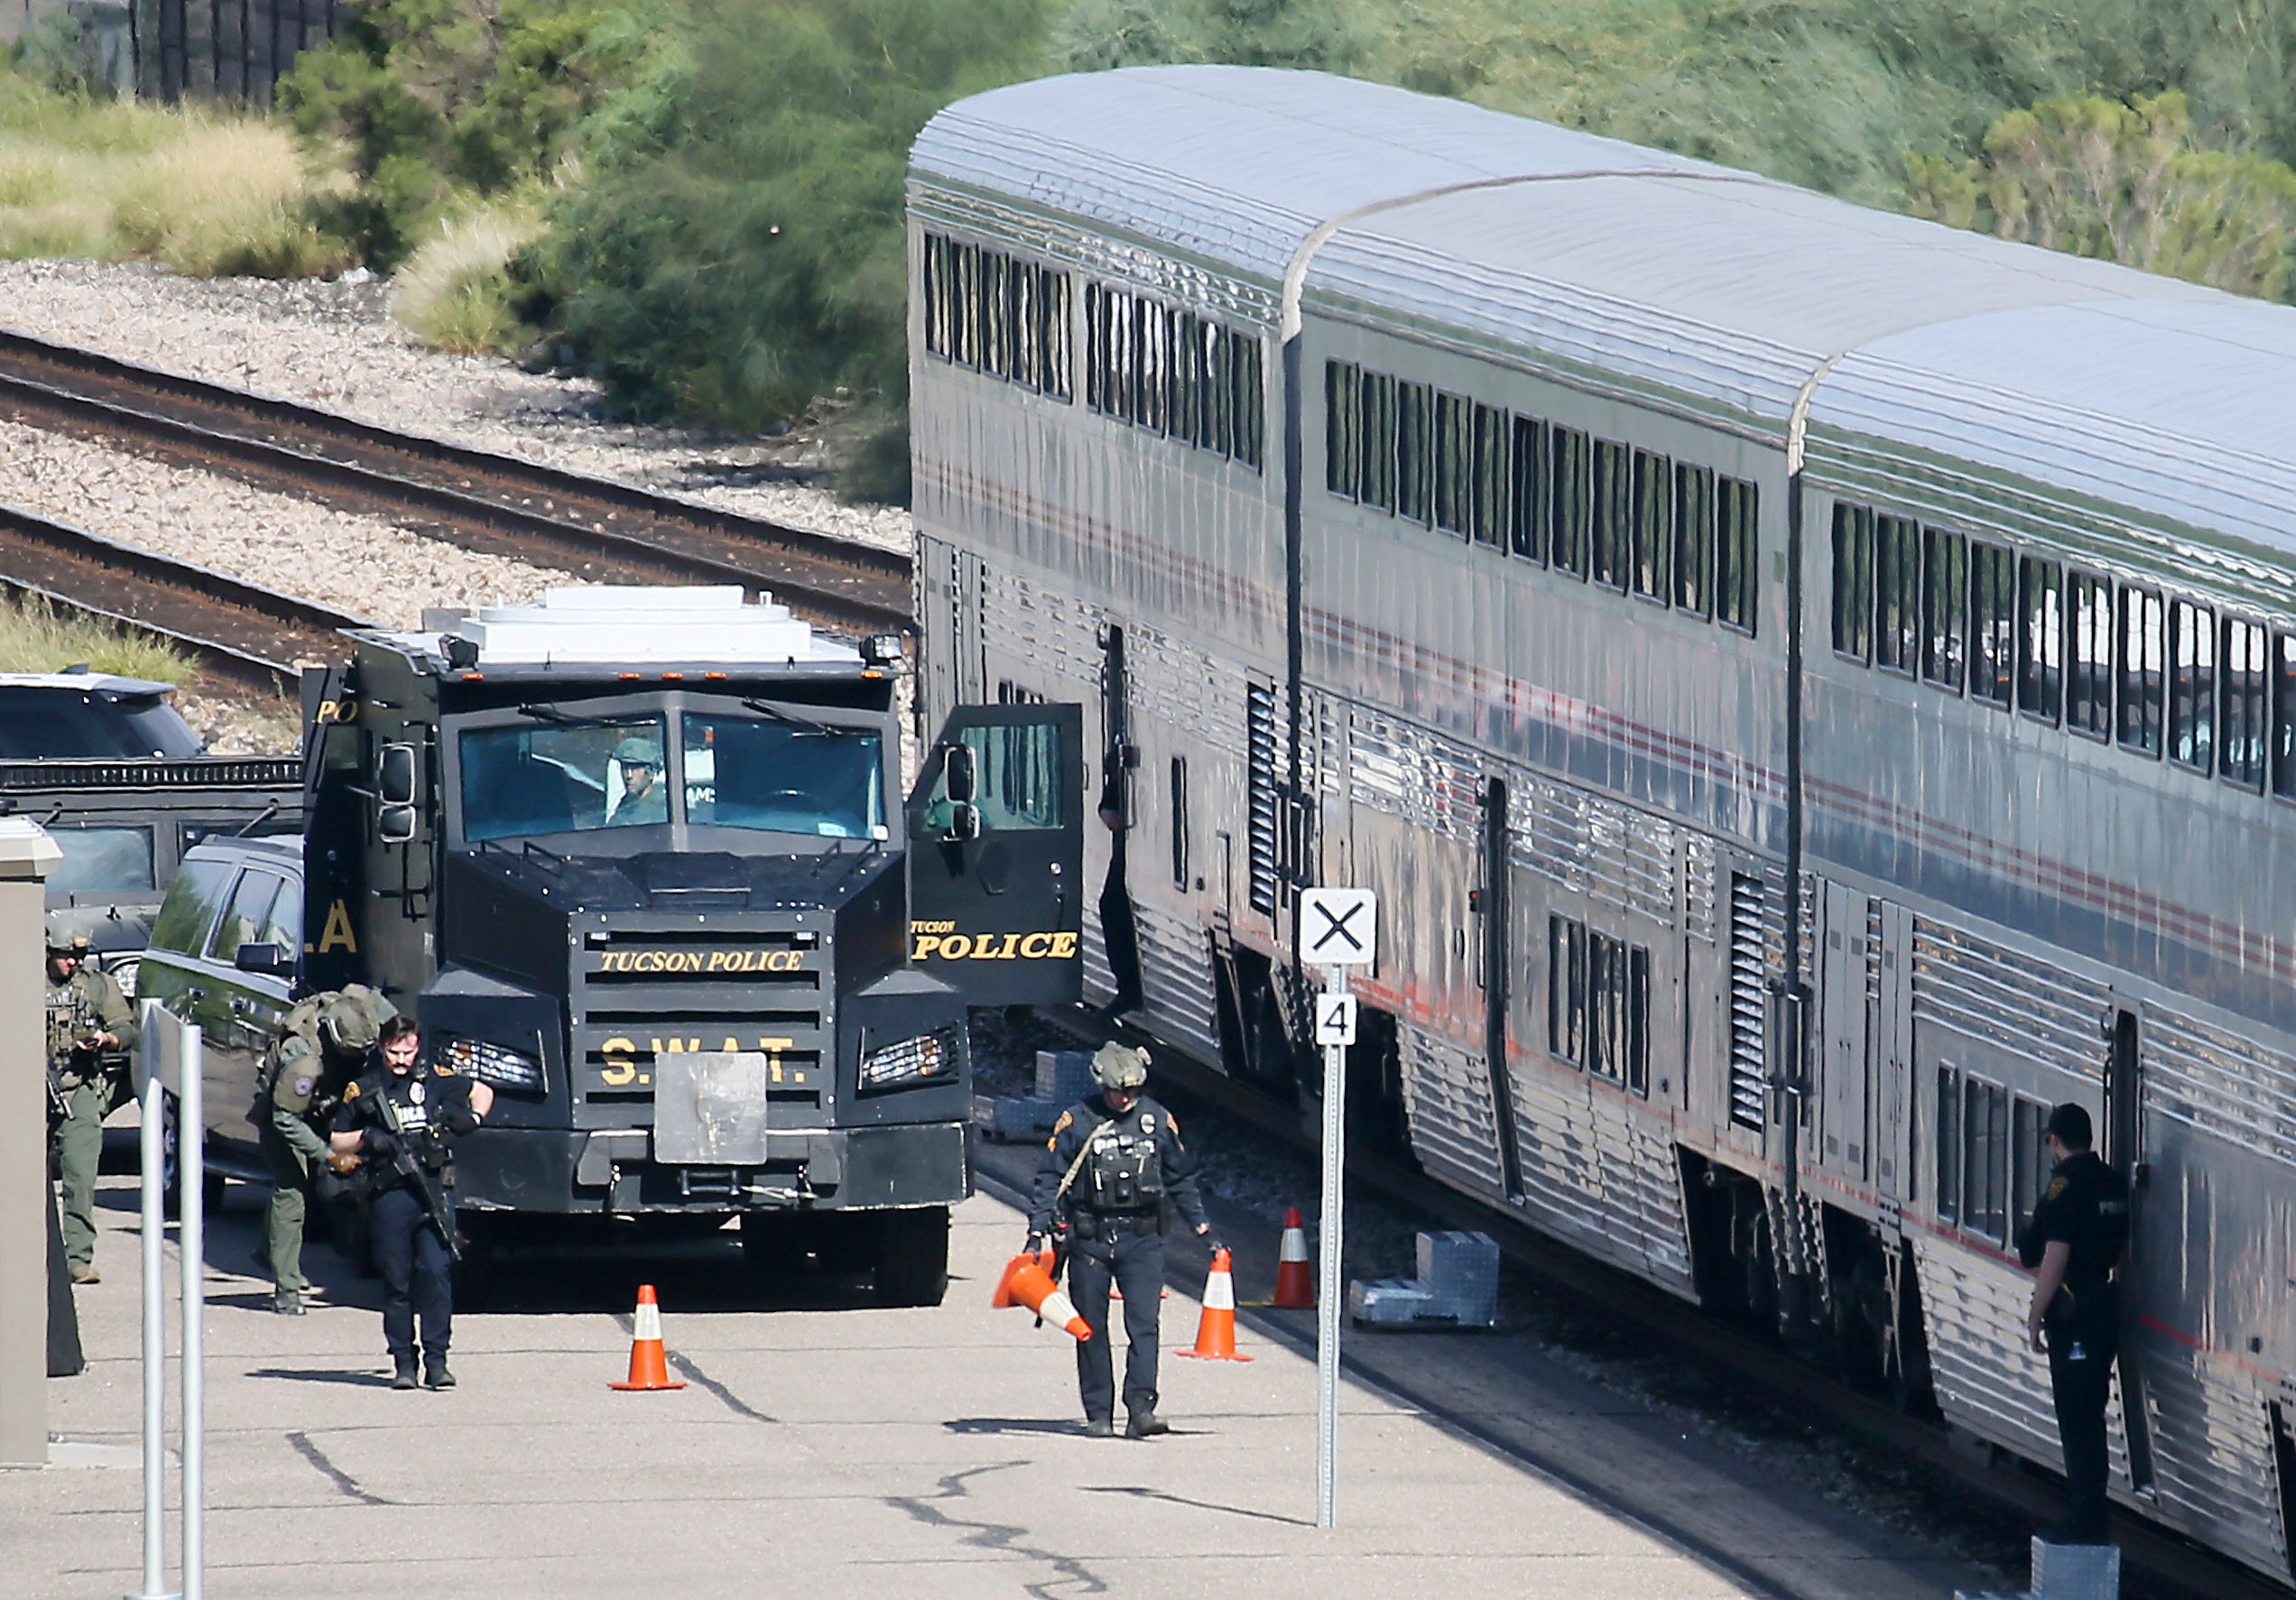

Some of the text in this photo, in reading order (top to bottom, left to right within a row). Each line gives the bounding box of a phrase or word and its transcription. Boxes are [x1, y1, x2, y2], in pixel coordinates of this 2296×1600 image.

[910, 920, 956, 934] TUCSON
[911, 932, 1079, 961] POLICE
[601, 950, 804, 972] TUCSON POLICE
[1323, 1002, 1348, 1037] 4
